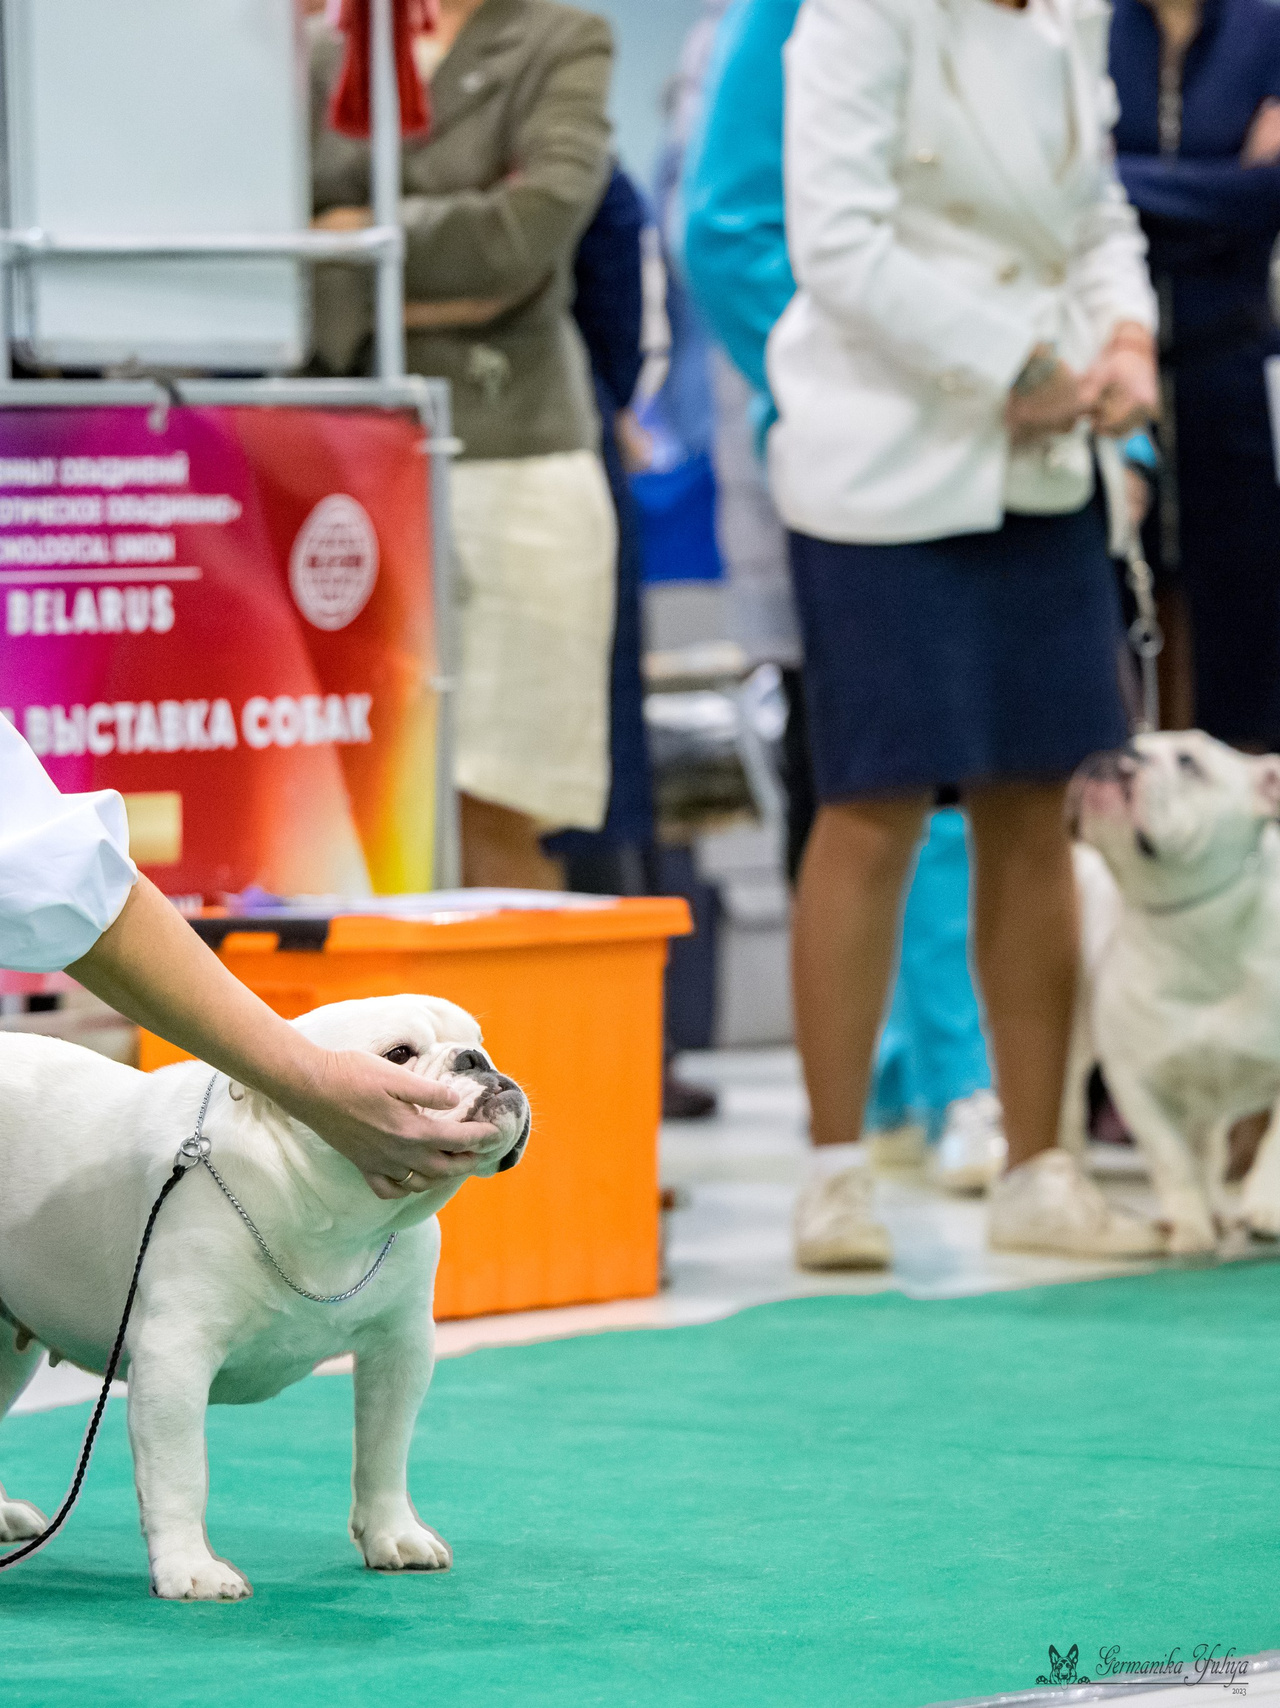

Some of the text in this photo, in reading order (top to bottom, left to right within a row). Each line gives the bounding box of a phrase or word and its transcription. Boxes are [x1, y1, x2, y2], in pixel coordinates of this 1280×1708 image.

[6, 584, 175, 637] BELARUS
[25, 698, 238, 757] ВЫСТАВКА
[241, 693, 374, 749] СОБАК
